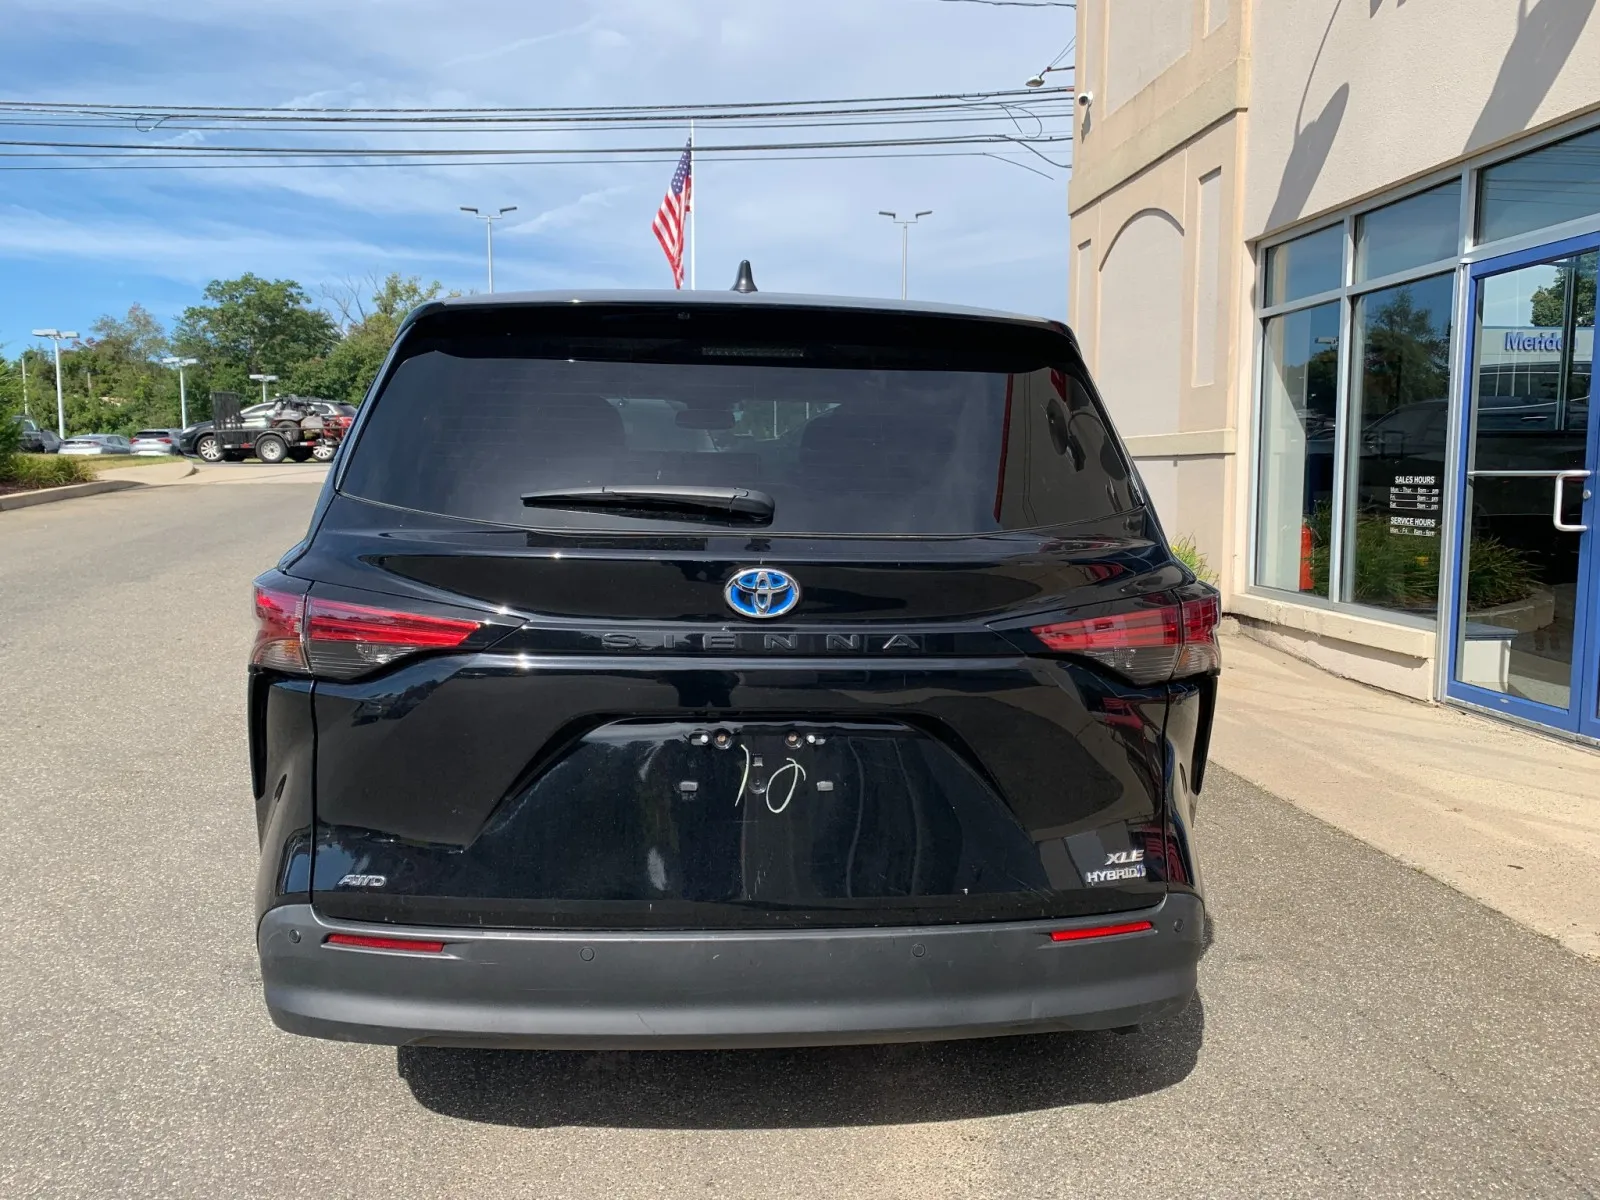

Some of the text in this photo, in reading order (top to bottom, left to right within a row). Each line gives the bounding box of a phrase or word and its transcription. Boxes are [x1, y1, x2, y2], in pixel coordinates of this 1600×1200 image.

[1395, 476, 1435, 484] SALES HOURS
[1390, 516, 1436, 527] SERVICE HOURS
[601, 633, 920, 650] SIENNA
[735, 744, 806, 813] 10
[1105, 849, 1145, 865] XLE
[338, 874, 386, 887] AWD
[1087, 868, 1138, 883] HYBRID
